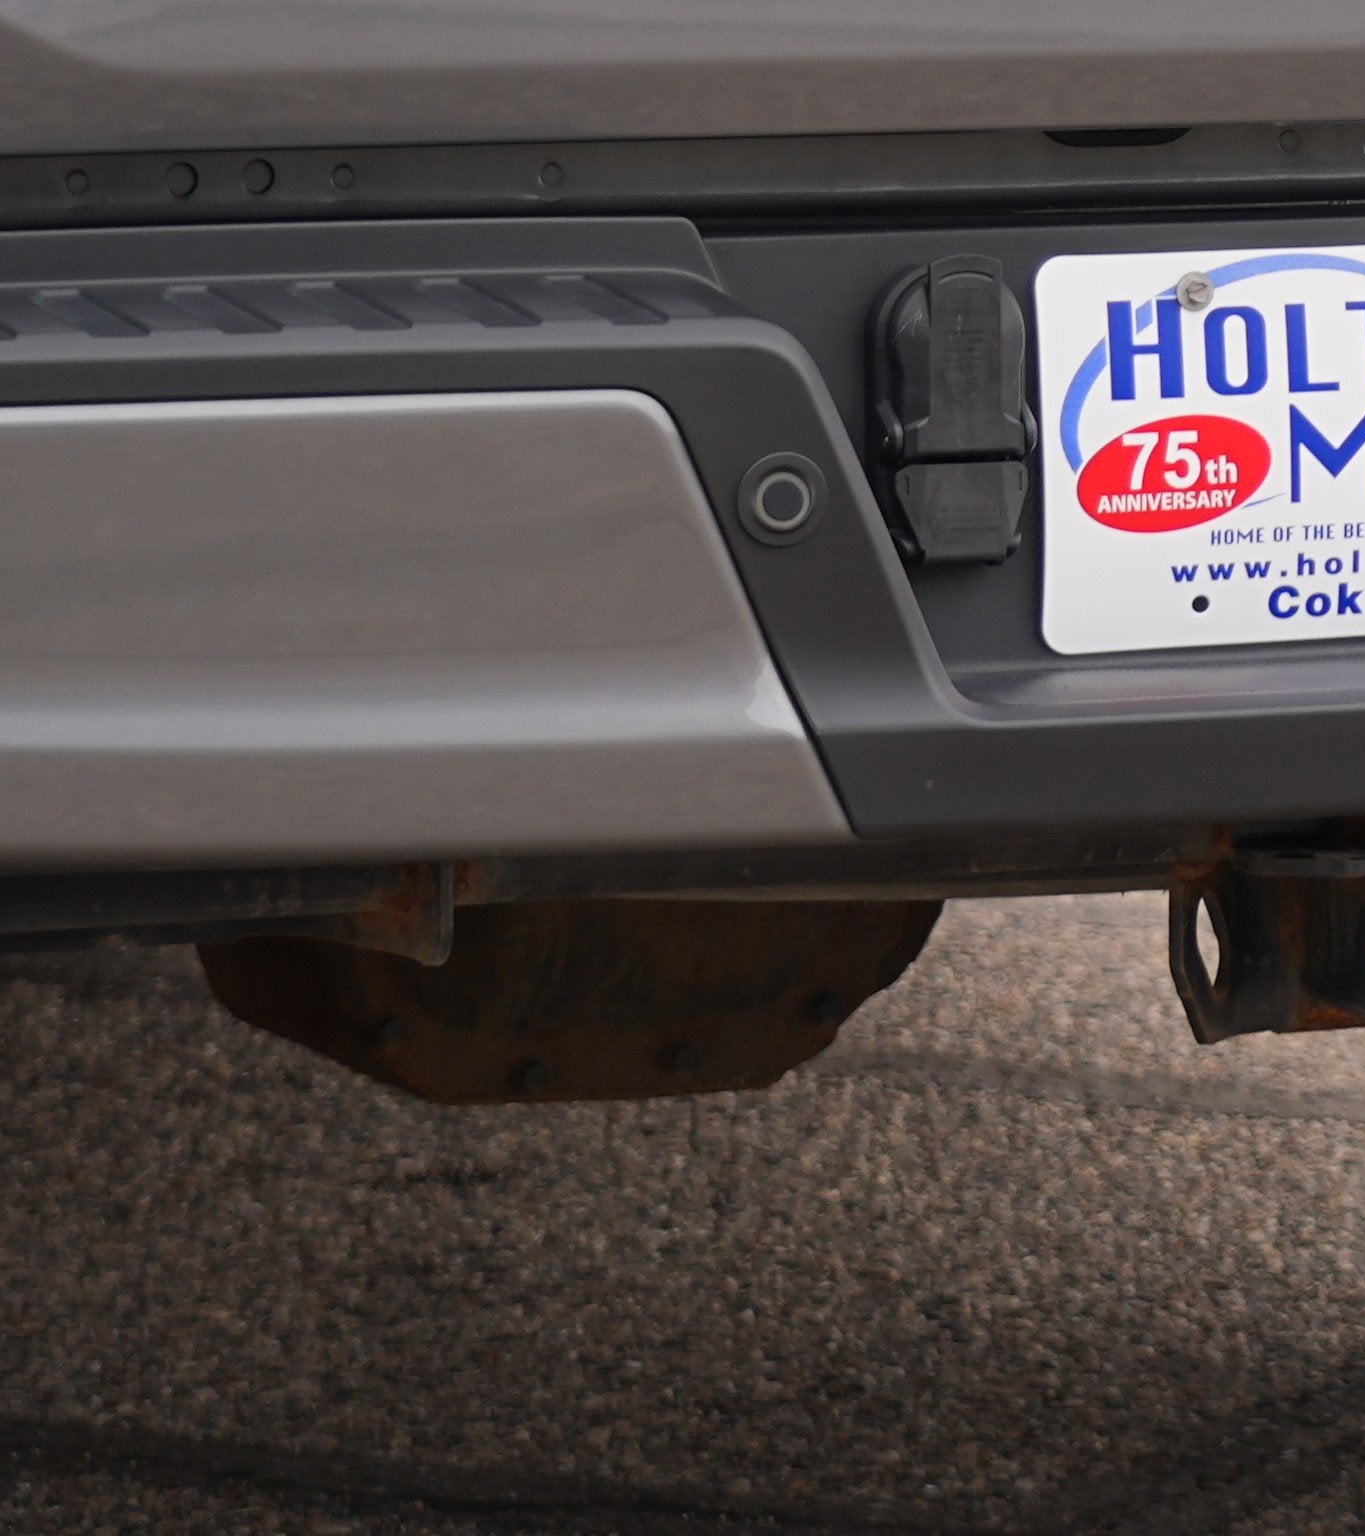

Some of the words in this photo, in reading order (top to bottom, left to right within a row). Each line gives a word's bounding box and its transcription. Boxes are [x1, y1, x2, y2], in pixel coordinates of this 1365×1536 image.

[1122, 430, 1238, 491] 75th
[1097, 488, 1237, 514] ANNIVERSARY
[1211, 527, 1265, 546] HOME
[1273, 525, 1295, 542] OF
[1303, 523, 1336, 541] THE
